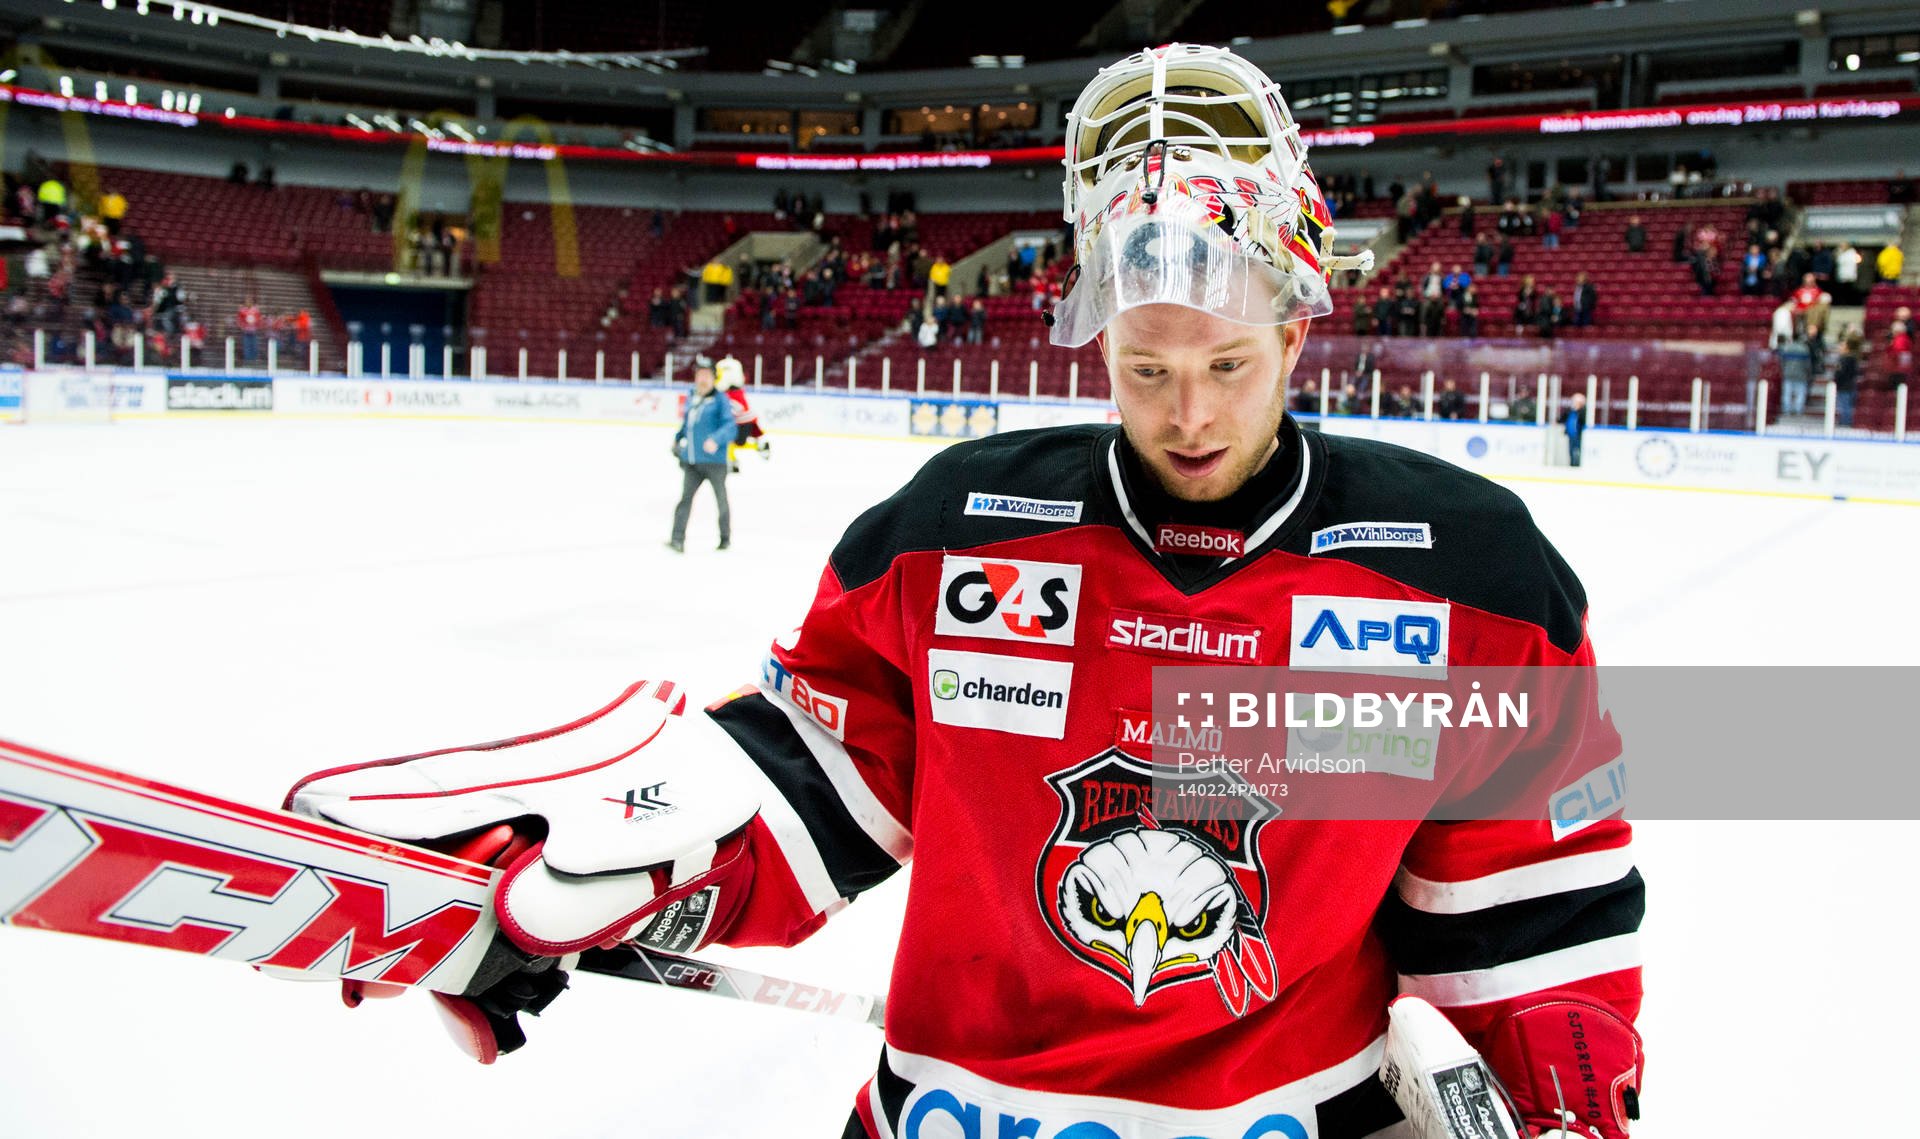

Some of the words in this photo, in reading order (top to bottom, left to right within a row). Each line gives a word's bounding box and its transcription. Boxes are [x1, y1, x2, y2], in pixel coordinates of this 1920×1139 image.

[168, 382, 272, 409] stadium
[1777, 450, 1831, 481] EY
[1007, 500, 1075, 517] Wihlborgs
[1160, 528, 1240, 553] Reebok
[1351, 527, 1424, 544] Wihlborgs
[945, 563, 1069, 638] G4S
[762, 653, 839, 731] T80
[963, 677, 1063, 708] charden
[1121, 718, 1222, 753] MALMÖ
[1347, 725, 1431, 769] bring
[1078, 780, 1243, 851] REDHAWKS
[649, 900, 682, 942] Reebok
[753, 975, 847, 1015] CCM
[1584, 1086, 1601, 1119] #40
